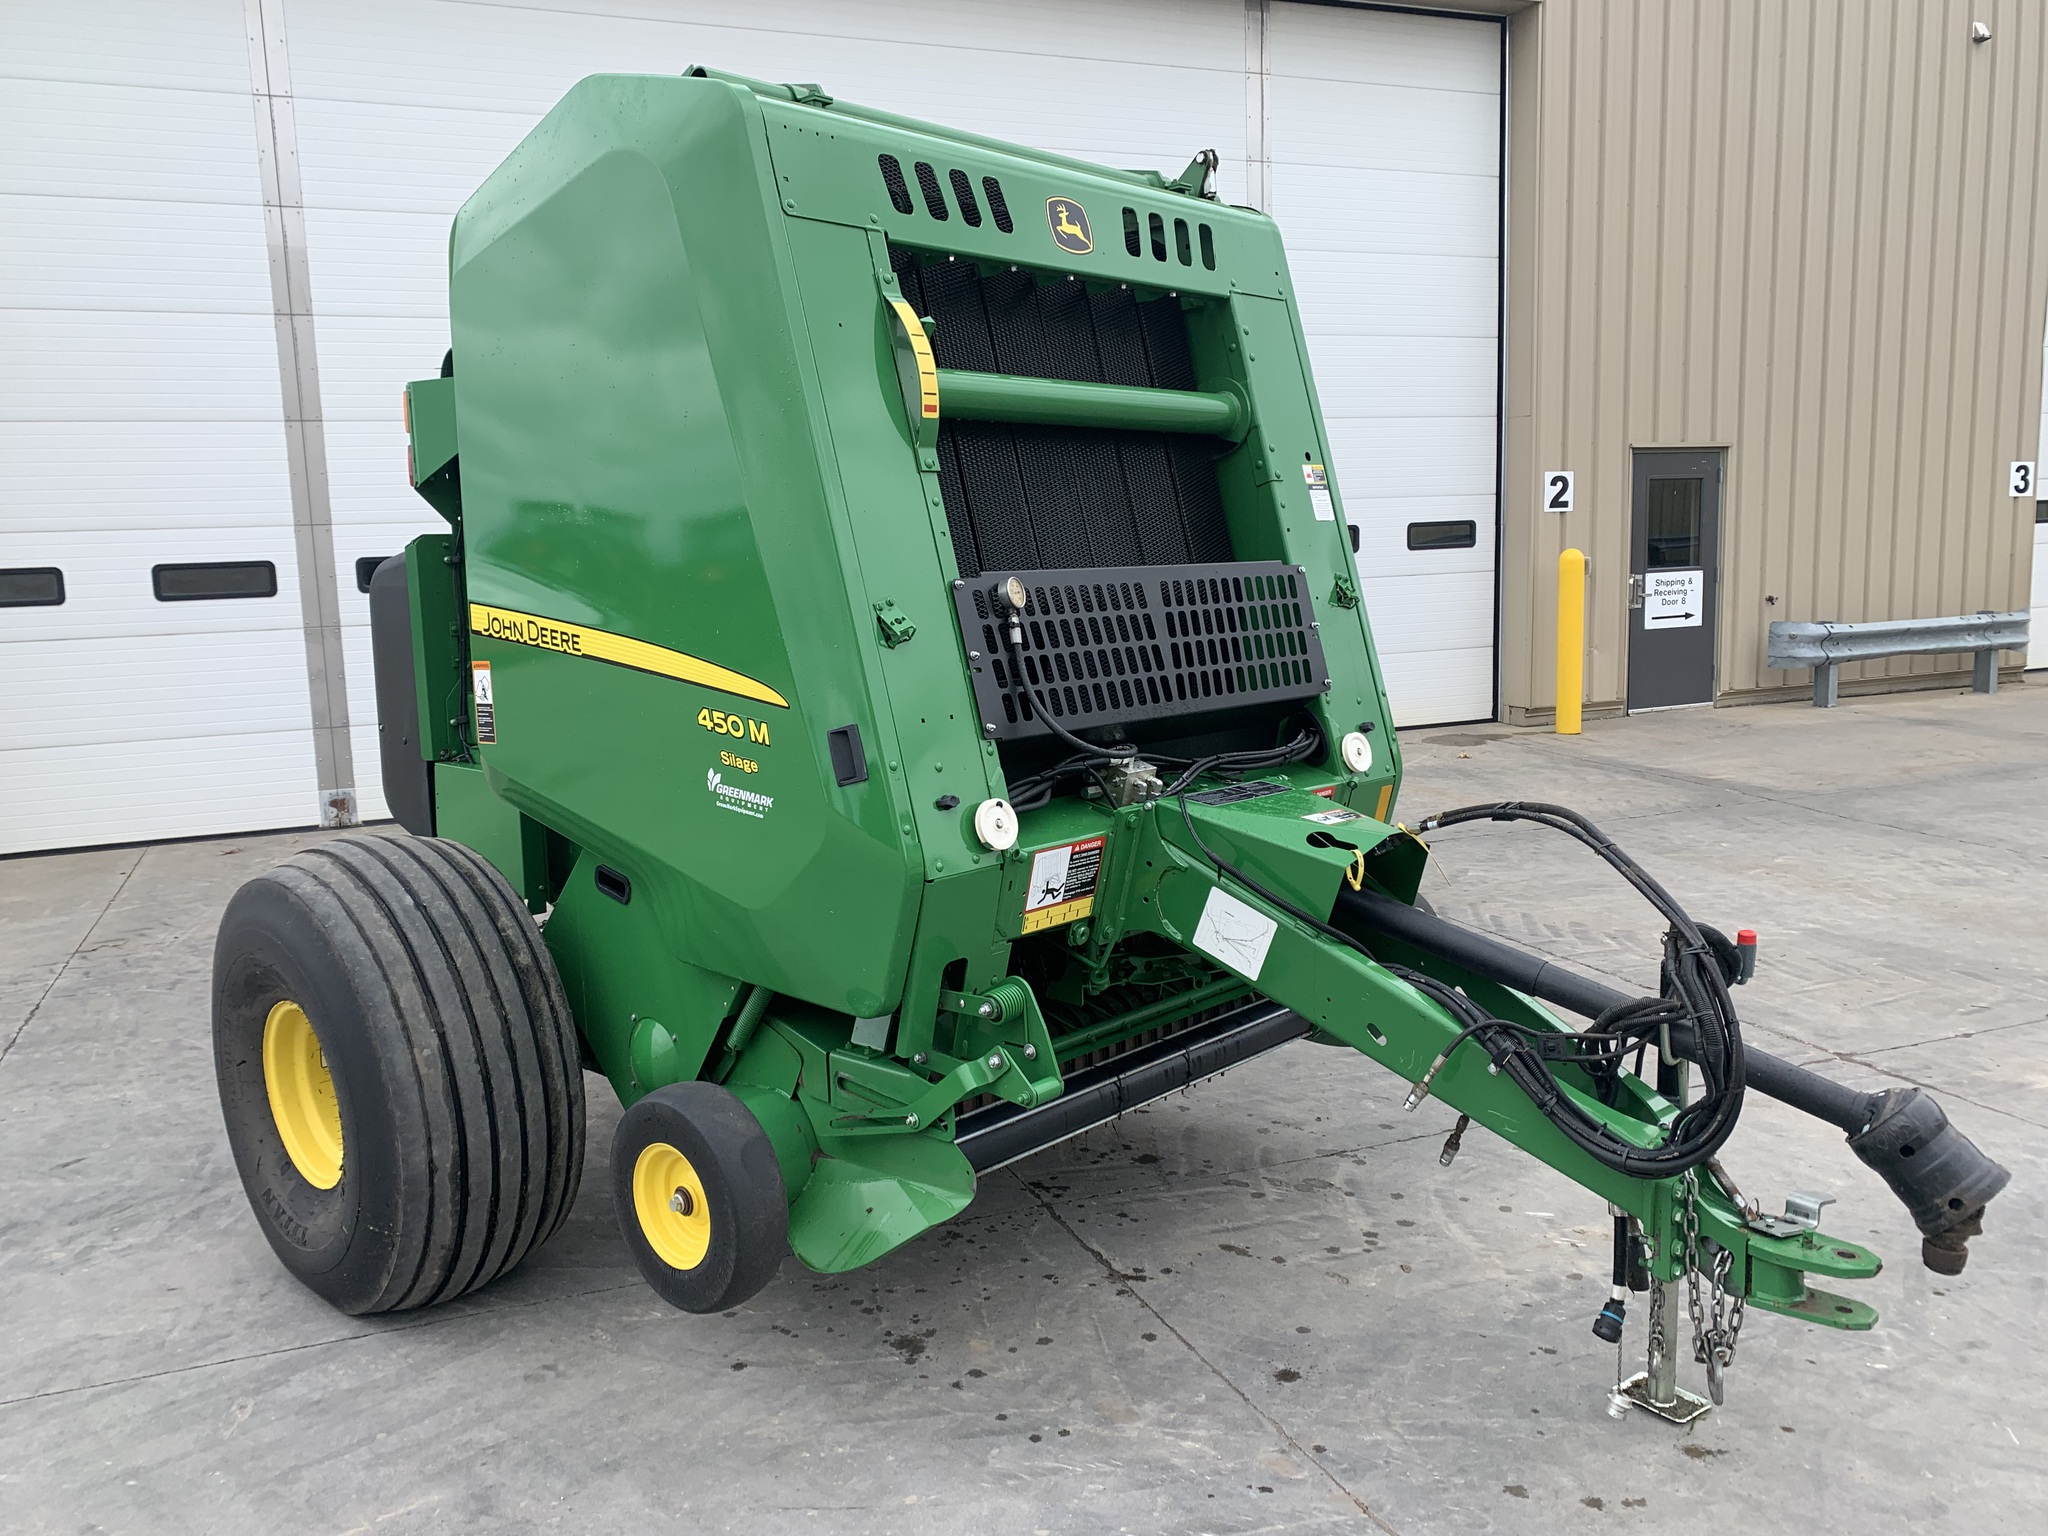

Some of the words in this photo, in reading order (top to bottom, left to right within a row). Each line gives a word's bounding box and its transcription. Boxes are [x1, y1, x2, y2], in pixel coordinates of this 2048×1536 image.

[2014, 464, 2030, 494] 3
[1549, 475, 1569, 509] 2
[1654, 588, 1688, 597] Receiving
[1655, 578, 1685, 588] Shipping
[1687, 577, 1693, 585] &
[1661, 598, 1679, 606] Door
[1681, 597, 1687, 605] 8
[483, 612, 524, 640] JOHN
[526, 619, 582, 653] DEERE
[697, 707, 745, 739] 450
[747, 717, 771, 747] M
[720, 749, 759, 774] Silage
[716, 783, 774, 808] GREENMARK
[719, 794, 769, 813] EQUIPMENT
[1080, 840, 1102, 851] DANGER
[261, 1187, 309, 1247] TITAN
